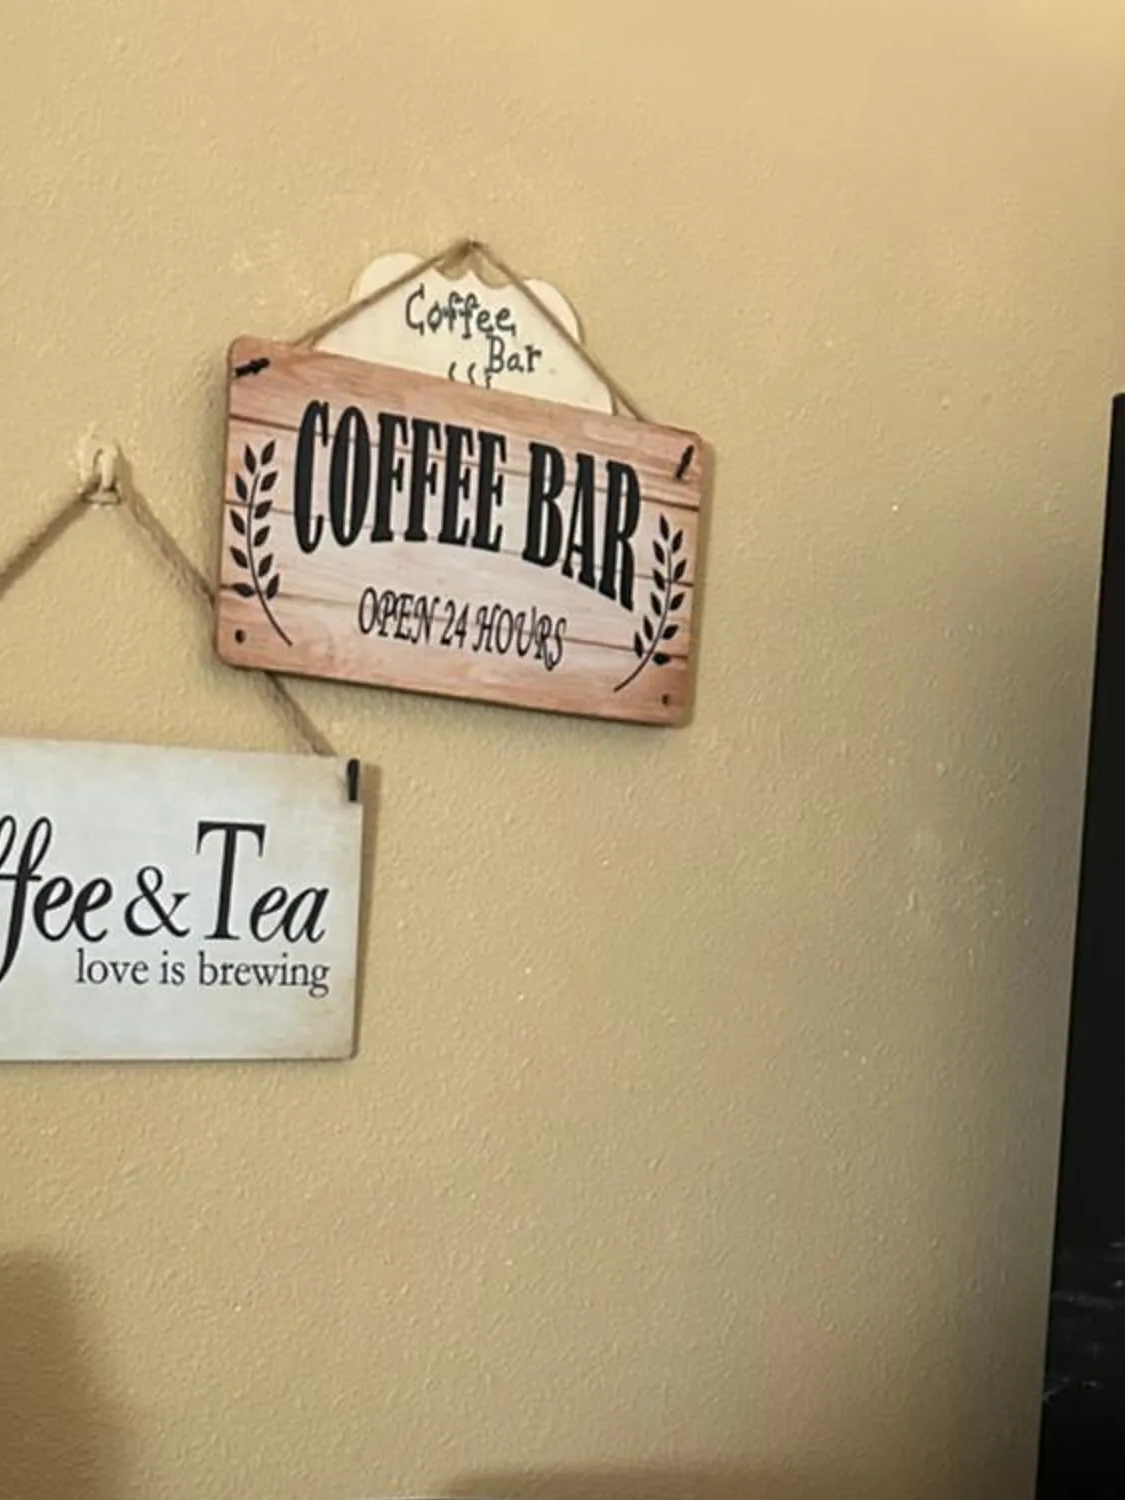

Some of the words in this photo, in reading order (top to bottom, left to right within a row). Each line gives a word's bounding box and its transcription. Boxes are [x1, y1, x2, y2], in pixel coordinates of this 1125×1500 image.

[405, 282, 516, 339] Coffee
[484, 333, 542, 374] Bar
[293, 400, 508, 555] COFFEE
[522, 441, 641, 611] BAR
[358, 586, 440, 645] OPEN
[440, 599, 470, 649] 24
[472, 603, 567, 671] HOURS
[123, 865, 191, 938] &
[196, 820, 331, 944] Tea
[75, 948, 149, 985] love
[159, 949, 185, 985] is
[198, 950, 331, 999] brewing
